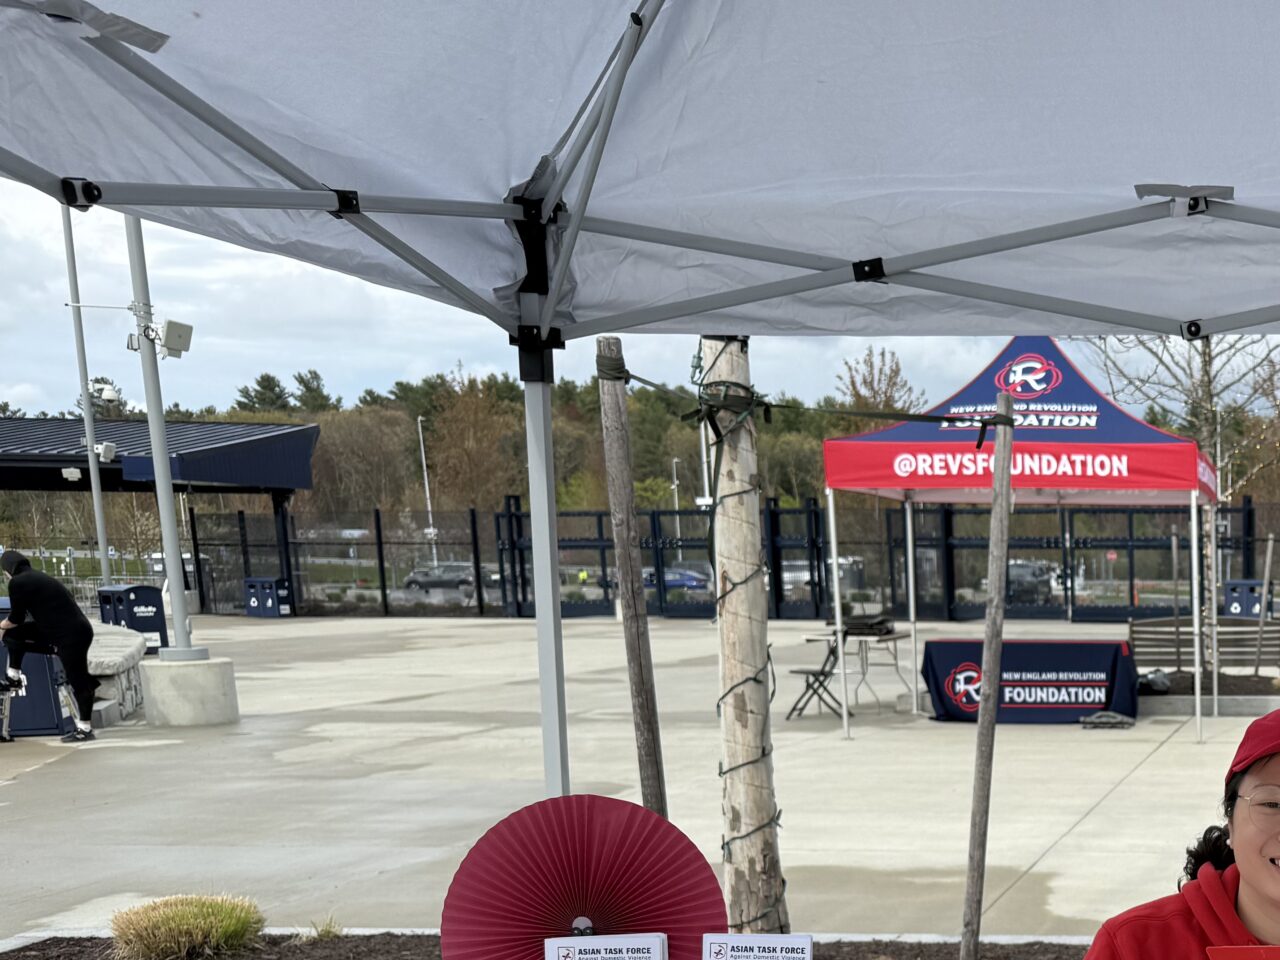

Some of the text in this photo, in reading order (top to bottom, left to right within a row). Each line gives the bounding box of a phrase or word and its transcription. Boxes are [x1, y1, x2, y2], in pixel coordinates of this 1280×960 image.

[950, 405, 975, 414] NEW
[1028, 404, 1097, 412] REVOLUTION
[893, 453, 1129, 477] @REVSFUNDATION
[1002, 672, 1106, 680] NEW ENGLAND REVOLUTION
[1004, 687, 1105, 702] FOUNDATION
[578, 948, 601, 956] ASIAN
[626, 947, 652, 955] FORCE
[730, 945, 806, 955] ASIAN TASK FORCE
